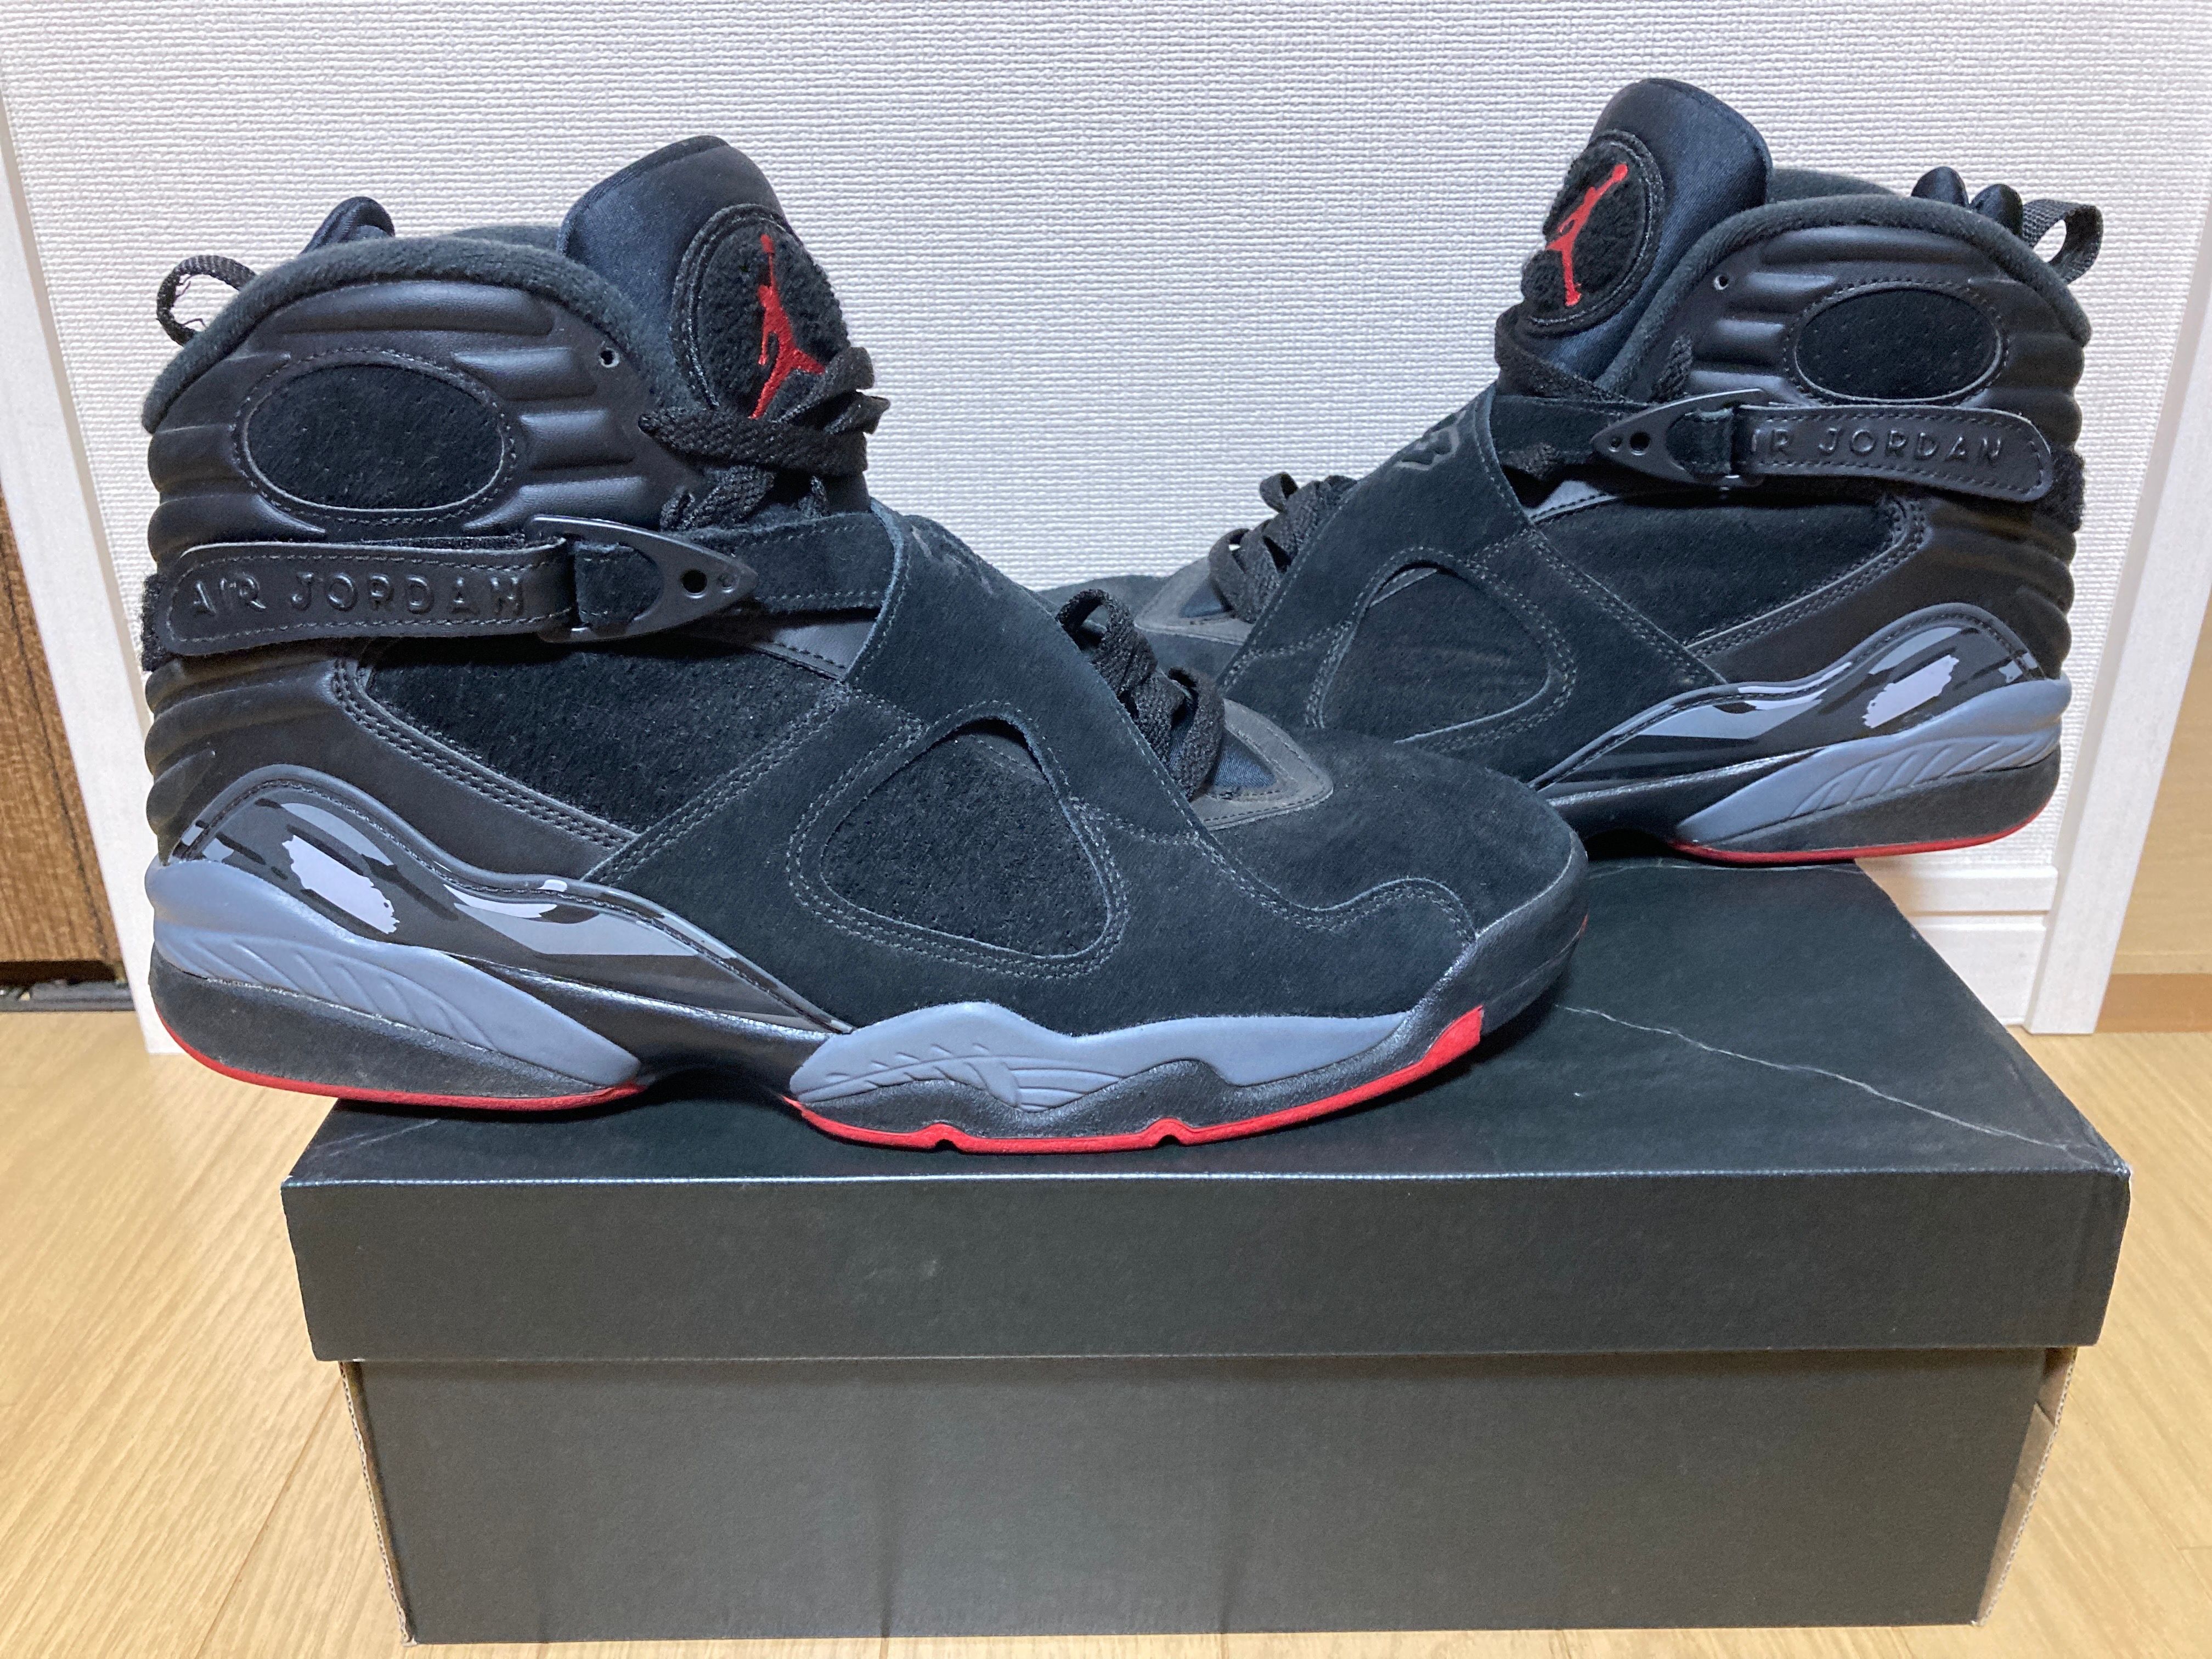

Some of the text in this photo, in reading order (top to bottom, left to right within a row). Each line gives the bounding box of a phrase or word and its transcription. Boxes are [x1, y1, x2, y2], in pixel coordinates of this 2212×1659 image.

[1818, 426, 2002, 462] JORDAN
[191, 572, 525, 616] AIR JORDAN
